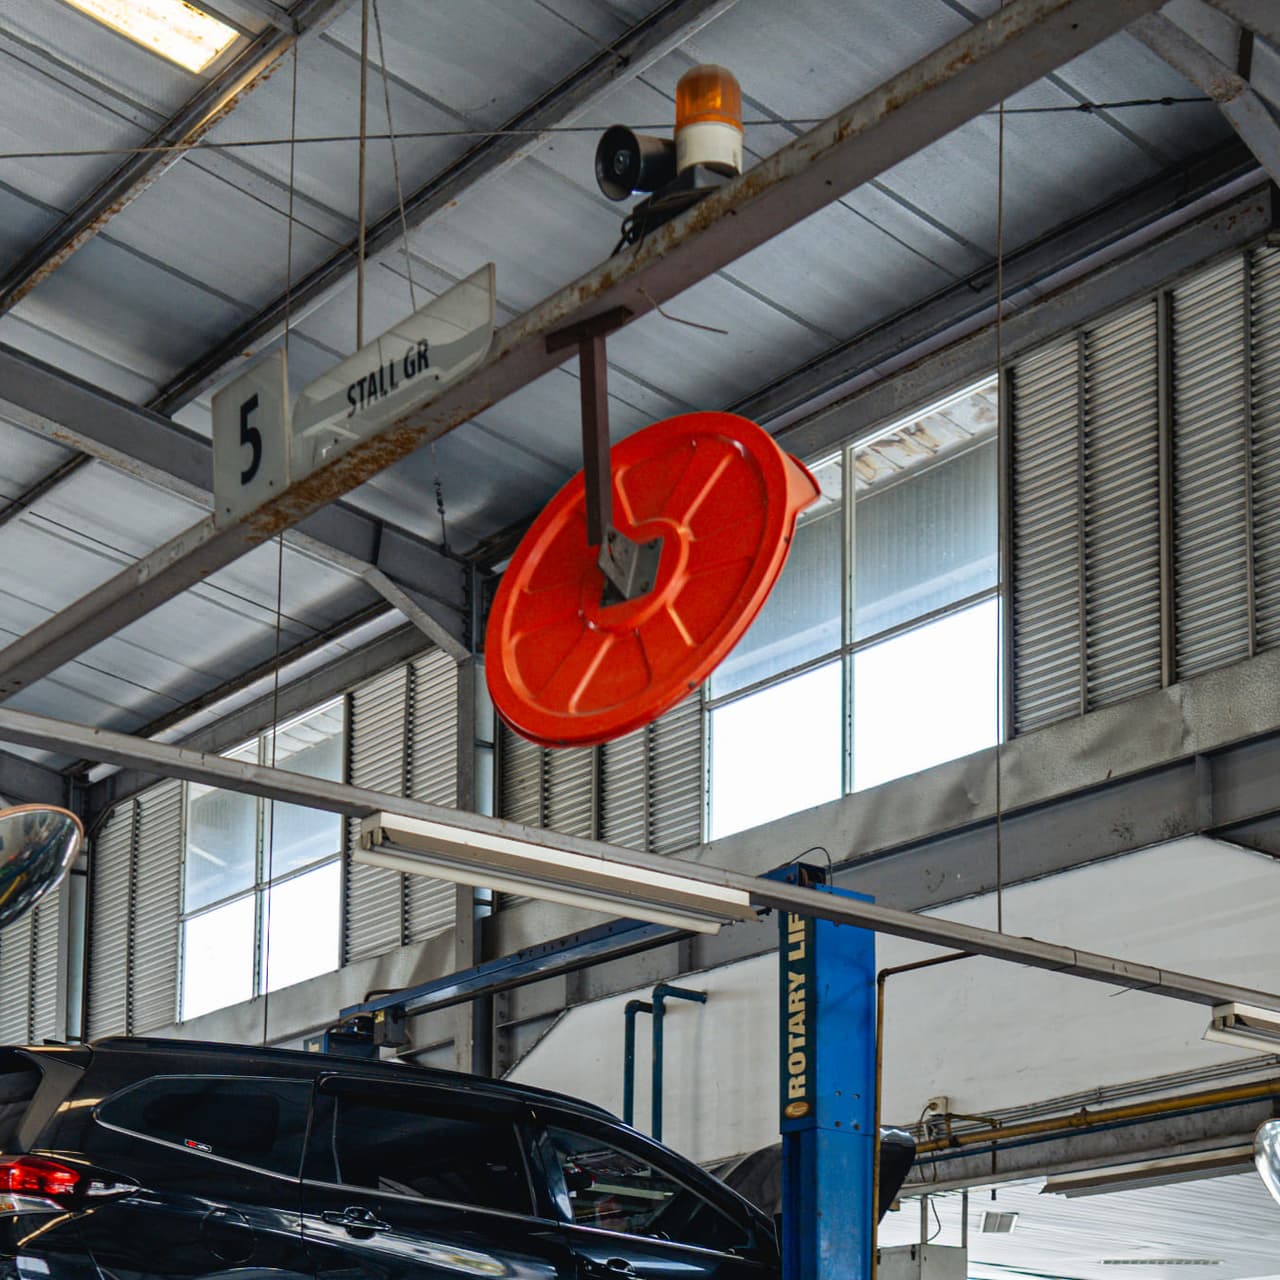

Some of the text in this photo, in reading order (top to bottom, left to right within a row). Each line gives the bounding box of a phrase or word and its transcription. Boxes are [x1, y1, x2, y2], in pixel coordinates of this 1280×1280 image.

[347, 338, 429, 418] STALL GR
[240, 393, 262, 485] 5
[787, 911, 807, 1099] ROTARY LIF
